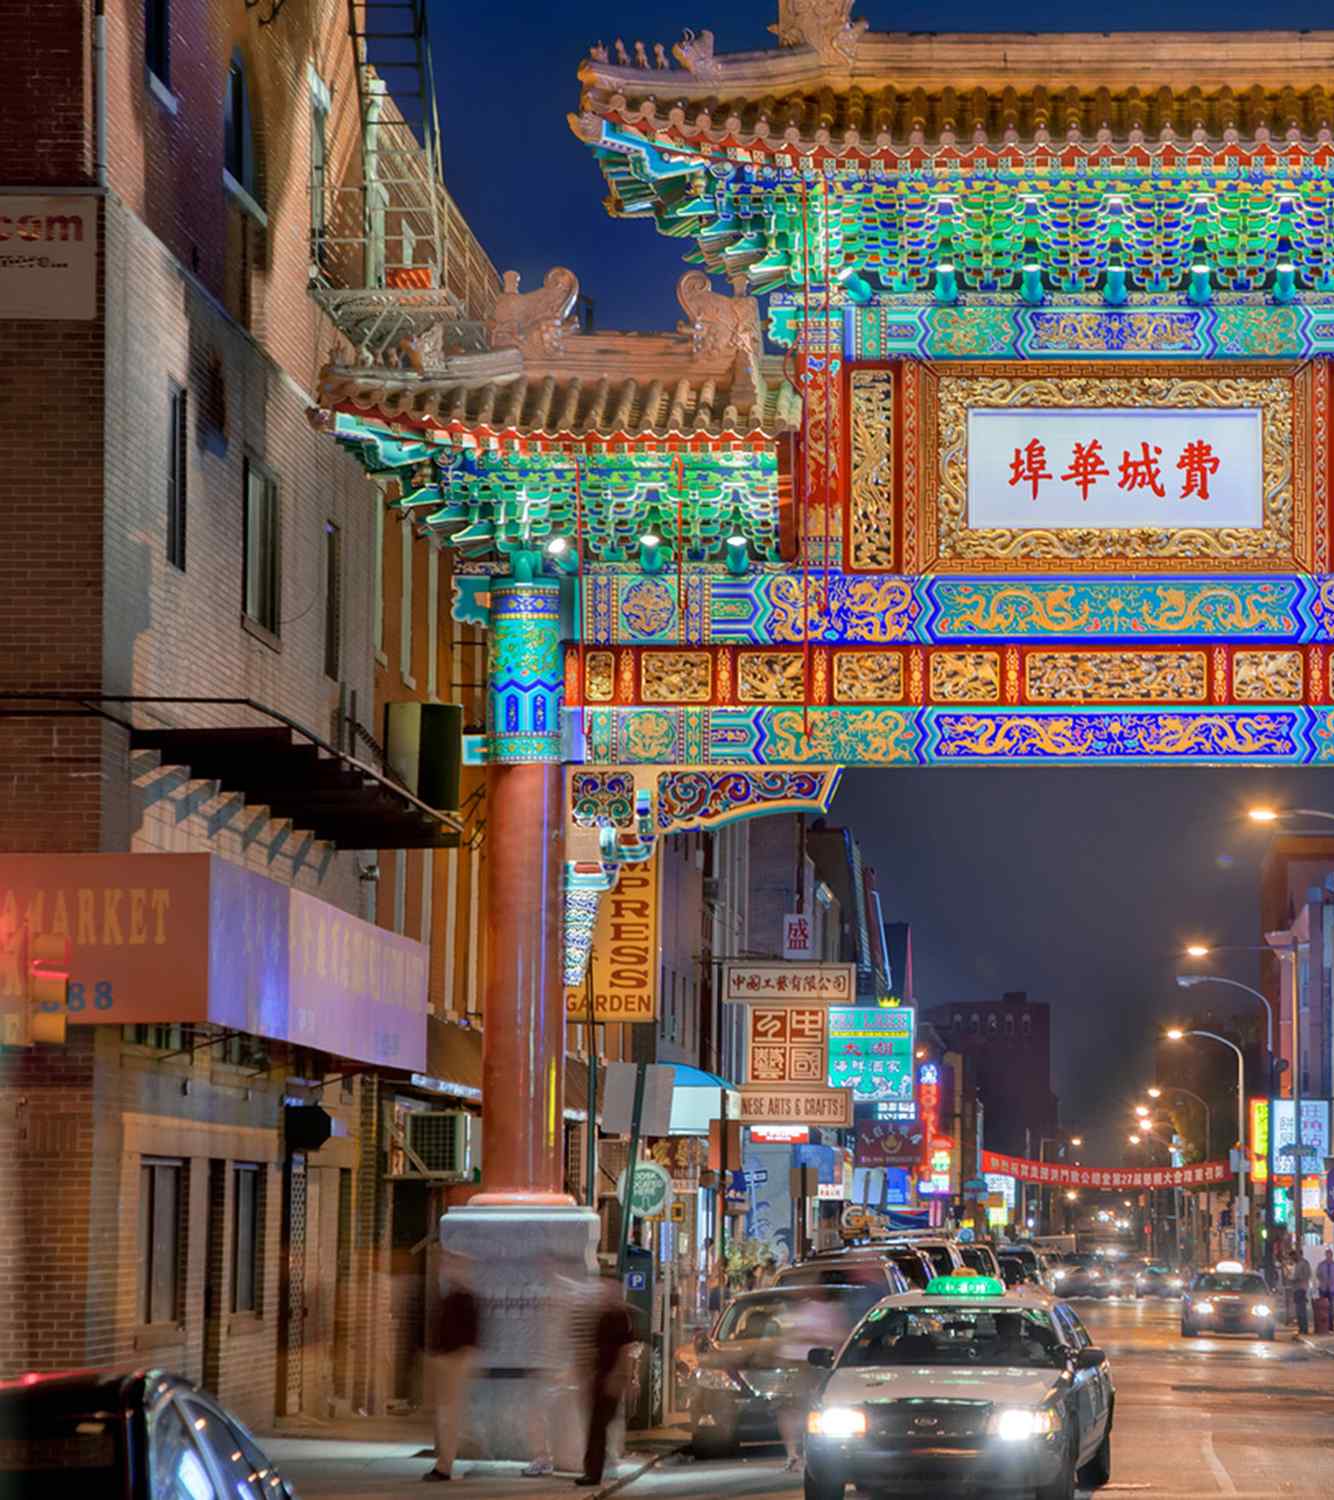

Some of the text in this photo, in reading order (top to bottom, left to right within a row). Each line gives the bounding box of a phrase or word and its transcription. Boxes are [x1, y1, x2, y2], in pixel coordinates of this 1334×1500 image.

[566, 994, 652, 1013] GARDEN
[767, 1097, 792, 1116] ARTS
[804, 1097, 838, 1116] CRAFTS
[631, 1274, 642, 1286] P
